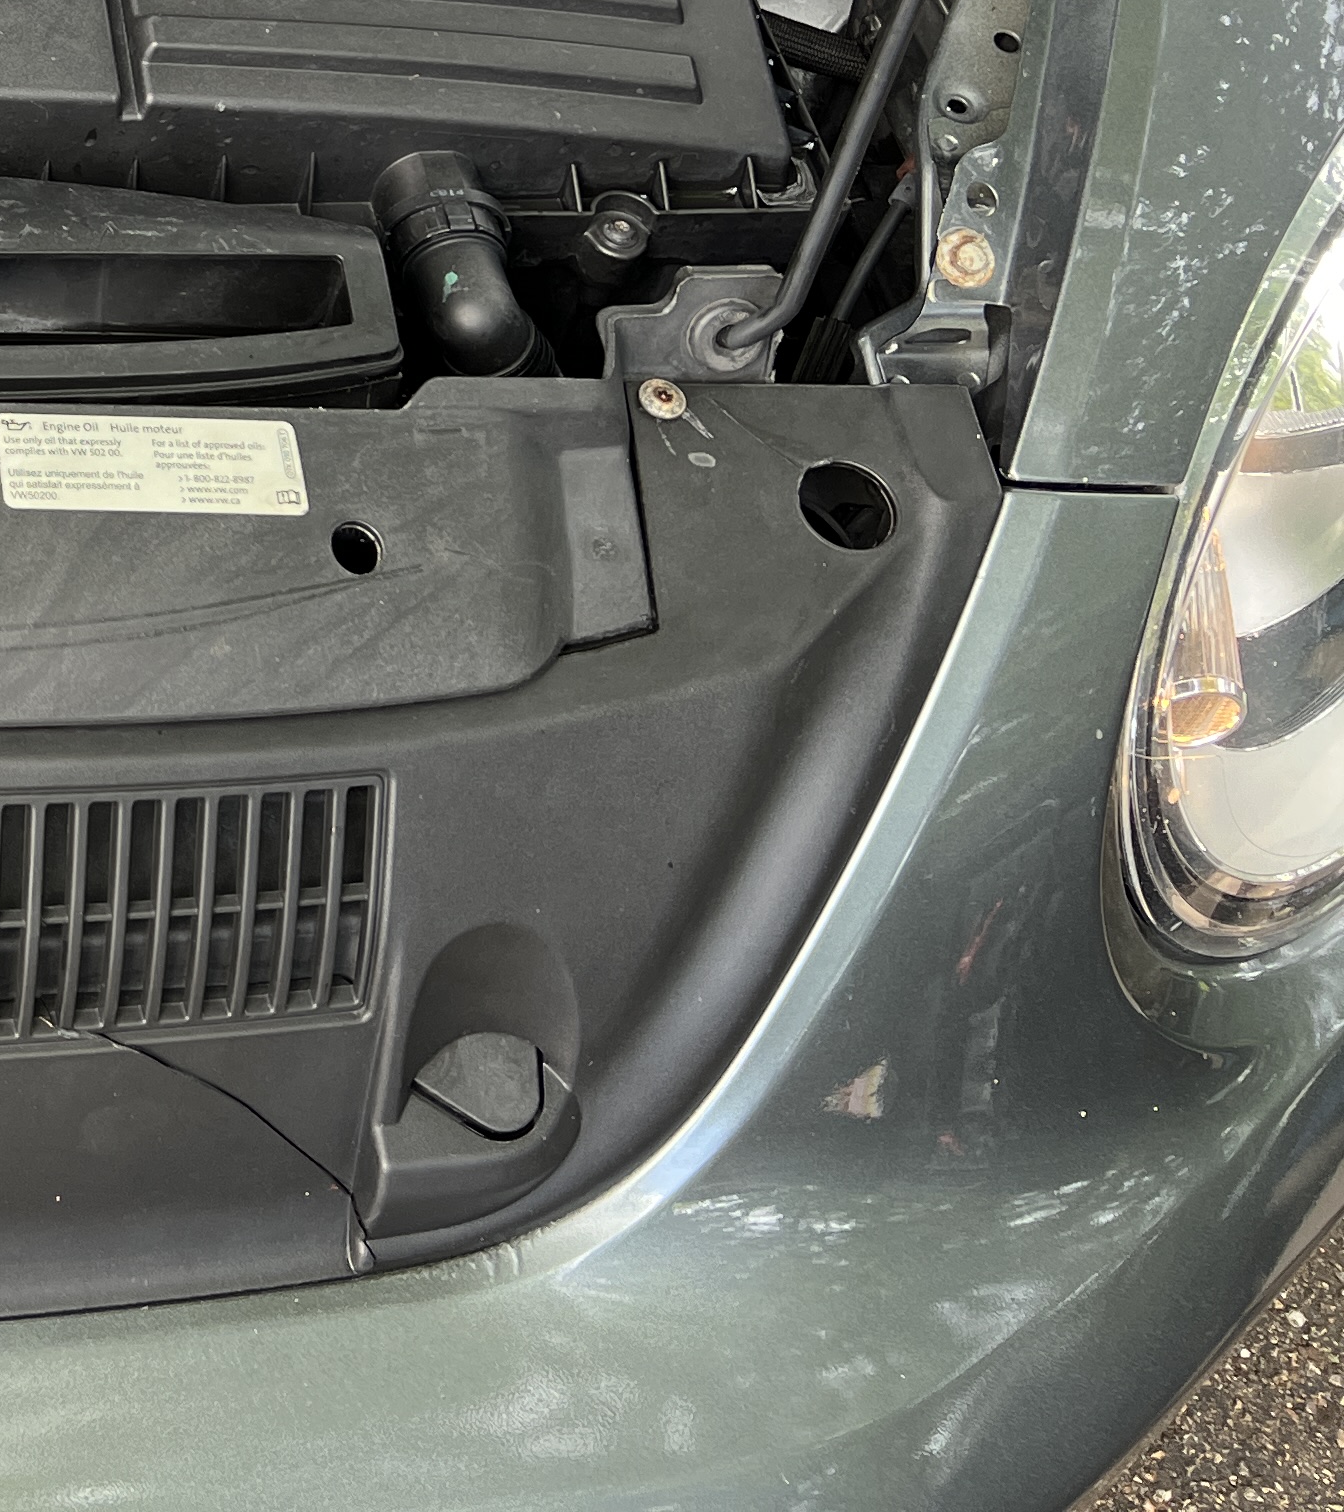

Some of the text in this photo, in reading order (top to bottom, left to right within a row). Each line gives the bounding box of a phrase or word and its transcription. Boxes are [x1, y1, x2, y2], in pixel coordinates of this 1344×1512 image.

[42, 421, 182, 434] Engine Oil Huile moteur
